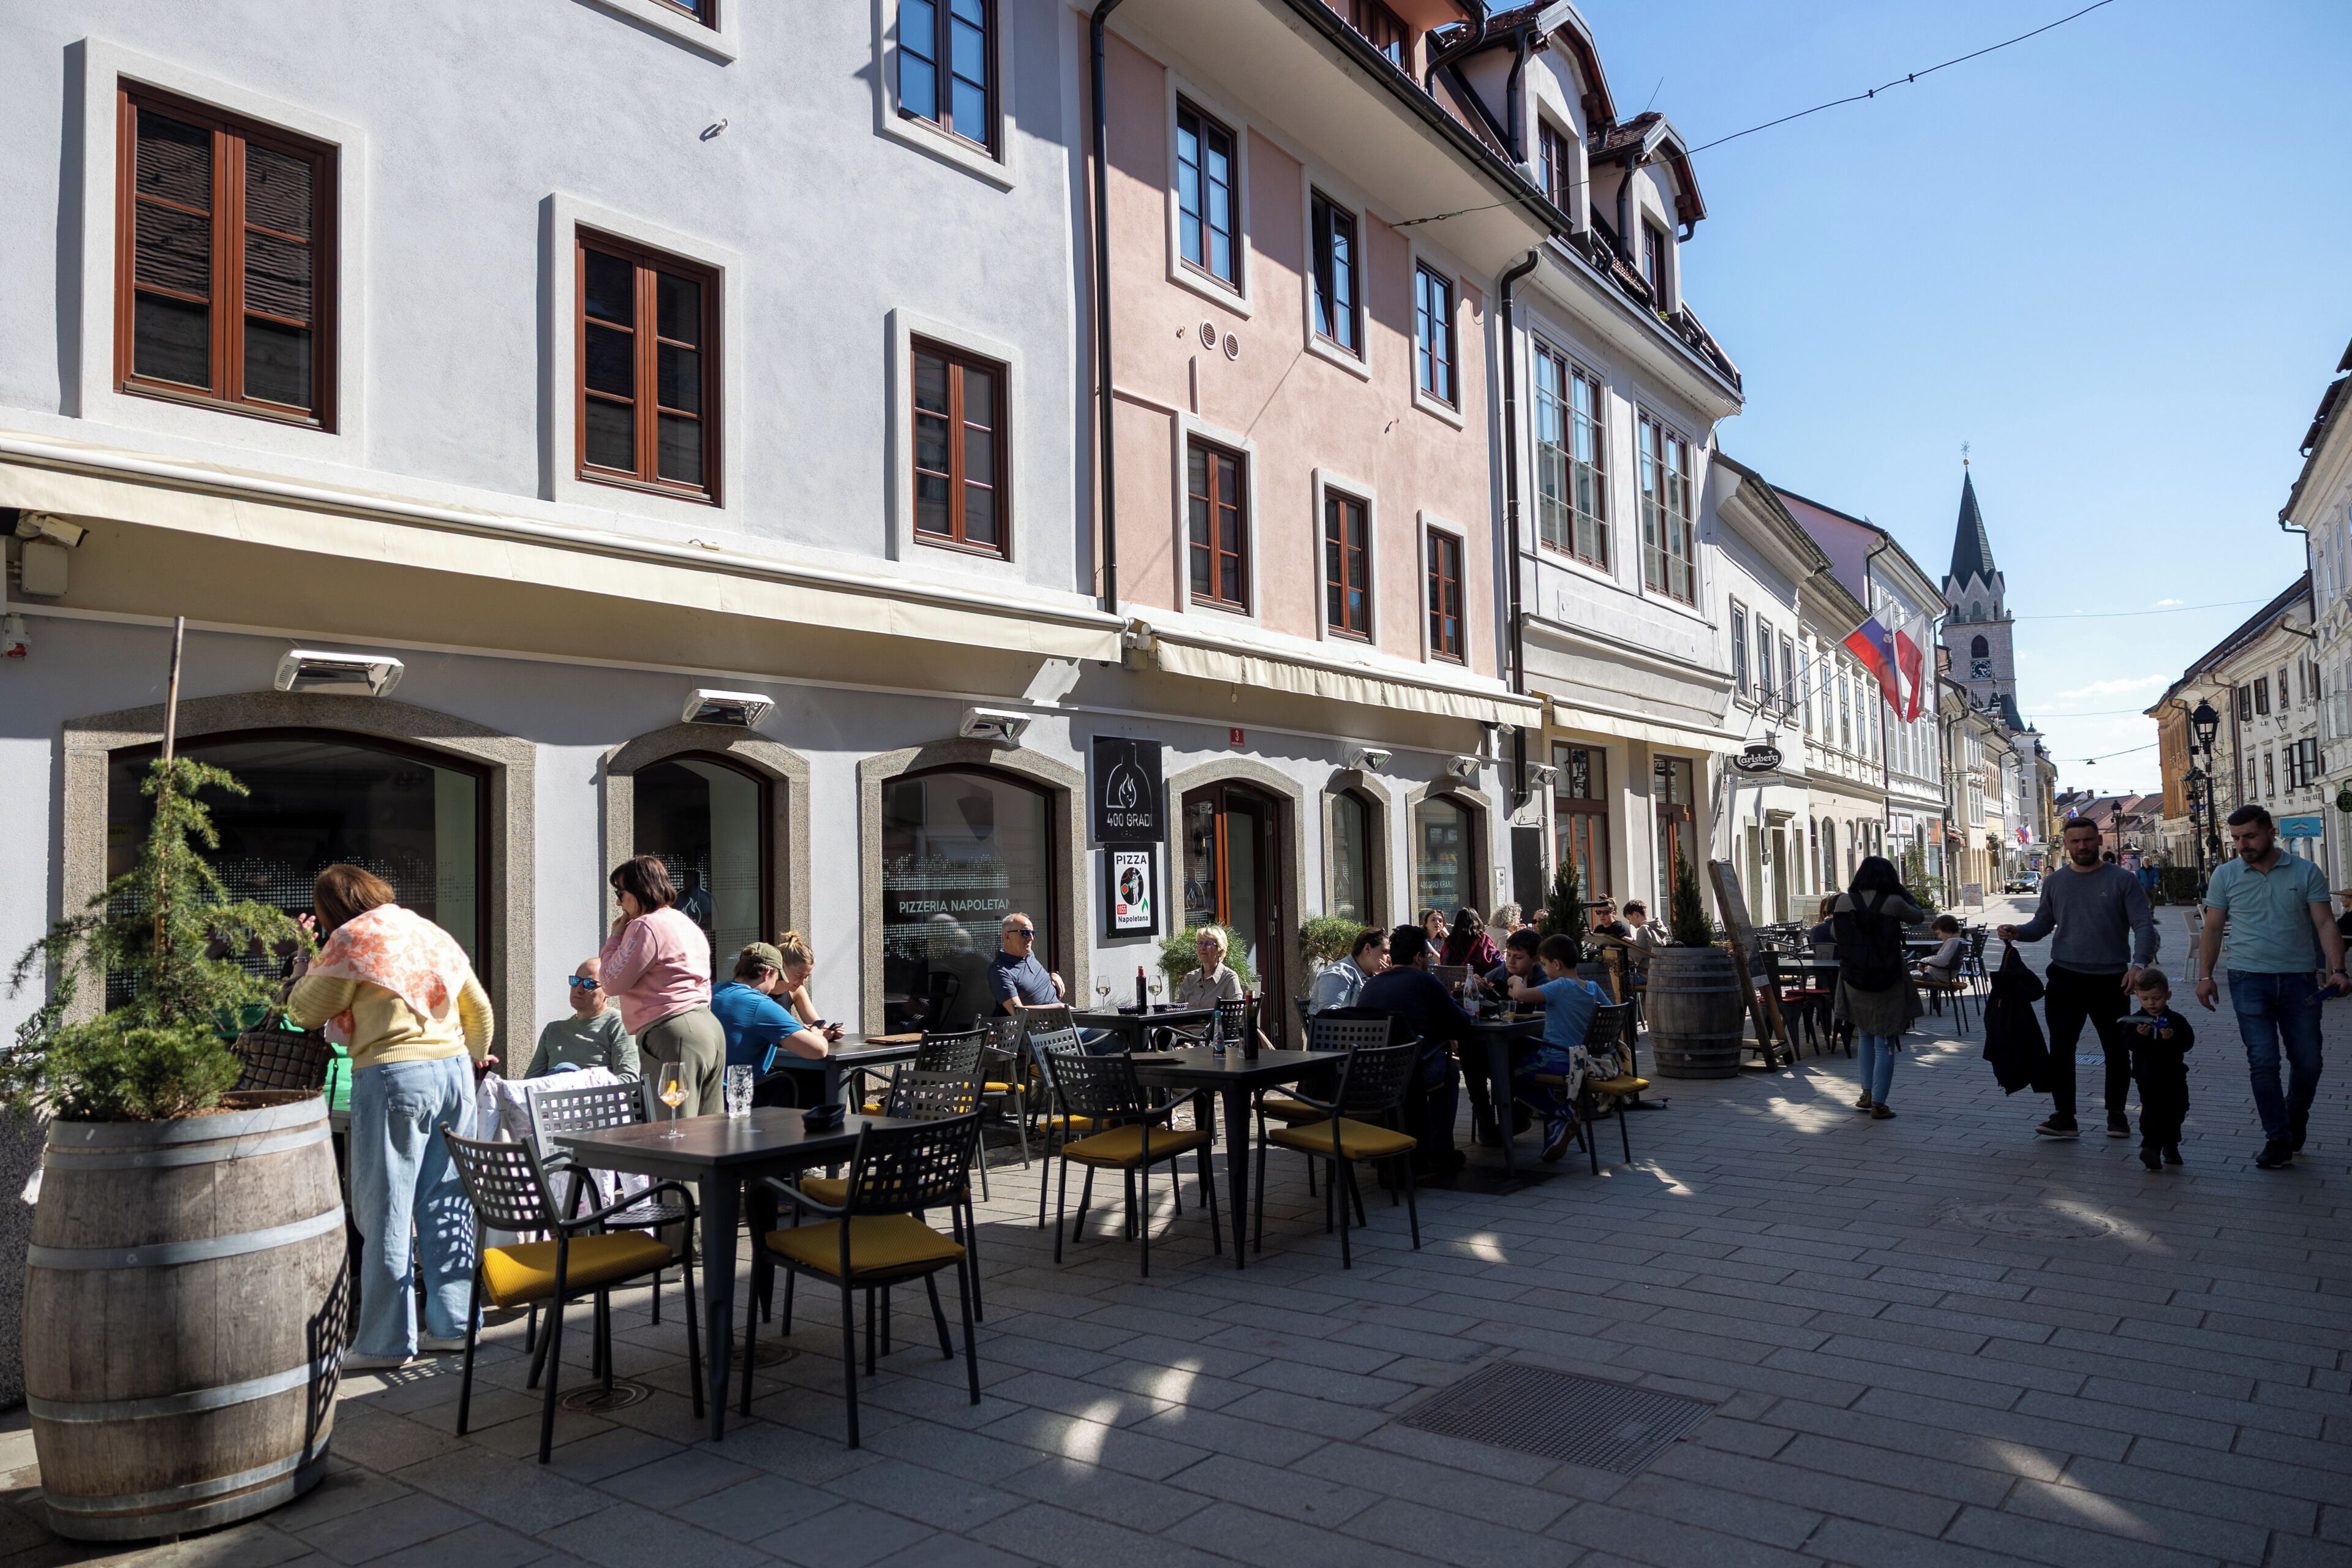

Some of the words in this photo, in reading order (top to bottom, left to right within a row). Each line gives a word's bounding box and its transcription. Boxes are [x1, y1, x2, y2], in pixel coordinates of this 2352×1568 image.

[1235, 729, 1240, 742] 3
[1737, 752, 1779, 766] Carlsberg
[1107, 813, 1124, 827] 400
[1127, 813, 1153, 827] GRADI
[1116, 855, 1147, 865] PIZZA
[899, 900, 948, 913] PIZZERIA
[1118, 905, 1126, 914] 1055
